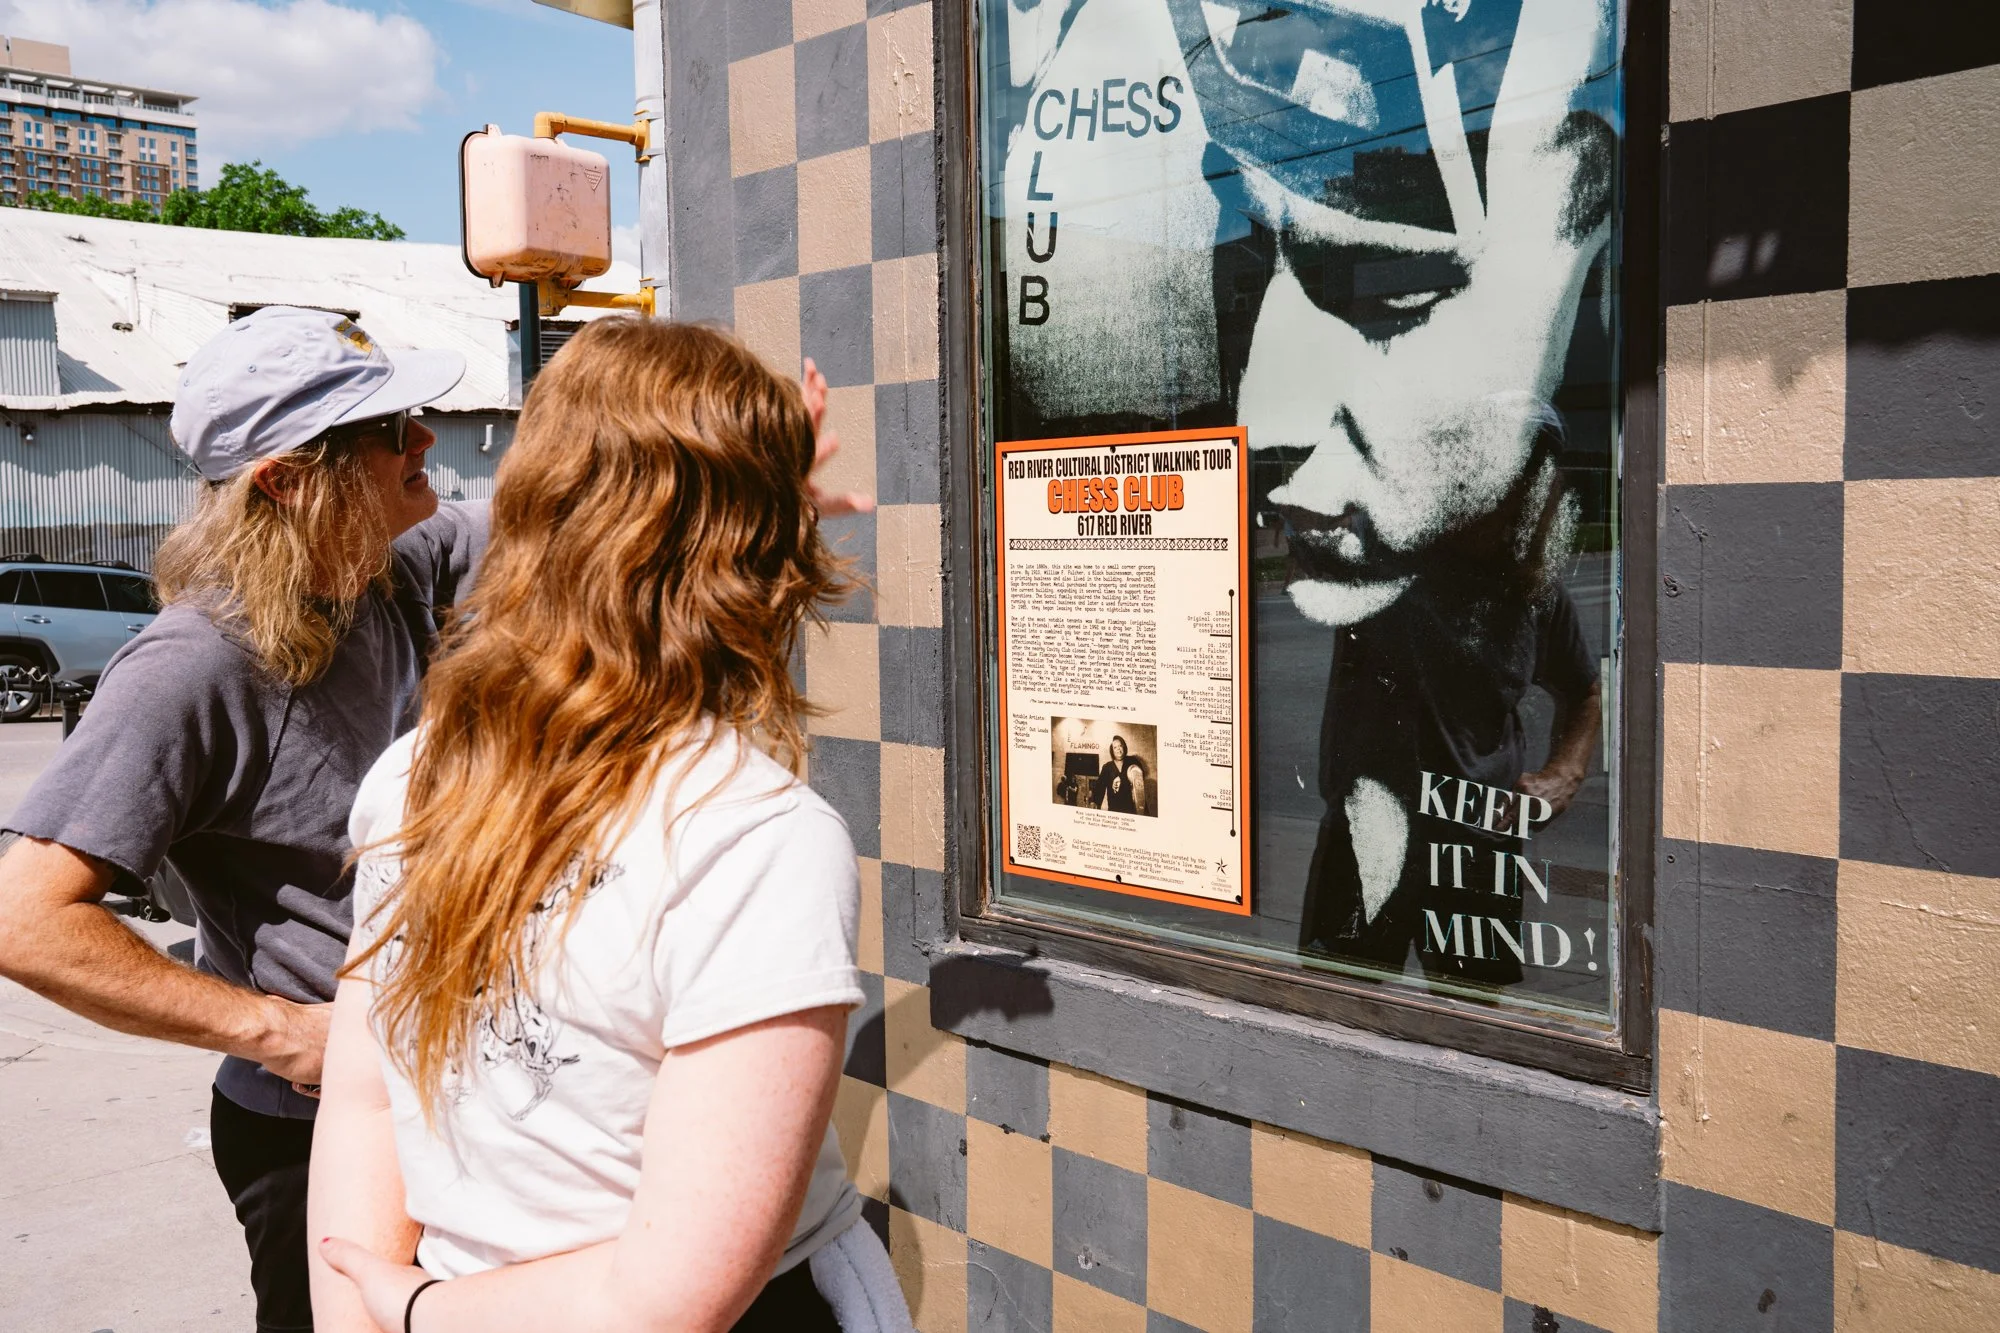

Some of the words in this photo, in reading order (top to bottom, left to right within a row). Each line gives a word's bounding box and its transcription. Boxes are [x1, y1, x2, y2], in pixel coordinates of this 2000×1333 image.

[1034, 76, 1183, 141] CHESS
[1008, 460, 1025, 479] RED
[1028, 458, 1053, 478] RIVER
[1056, 456, 1102, 477] CULTURAL
[1104, 453, 1150, 474] DISTRICT
[1152, 450, 1200, 472] WALKING
[1203, 448, 1231, 470] TOUR
[1047, 477, 1118, 514] CHESS
[1124, 474, 1184, 512] CLUB
[1078, 516, 1094, 536] 617
[1098, 515, 1117, 536] RED
[1120, 514, 1152, 536] RIVER
[1417, 771, 1551, 840] KEEP
[1428, 842, 1474, 888] IT
[1491, 850, 1552, 904] IN
